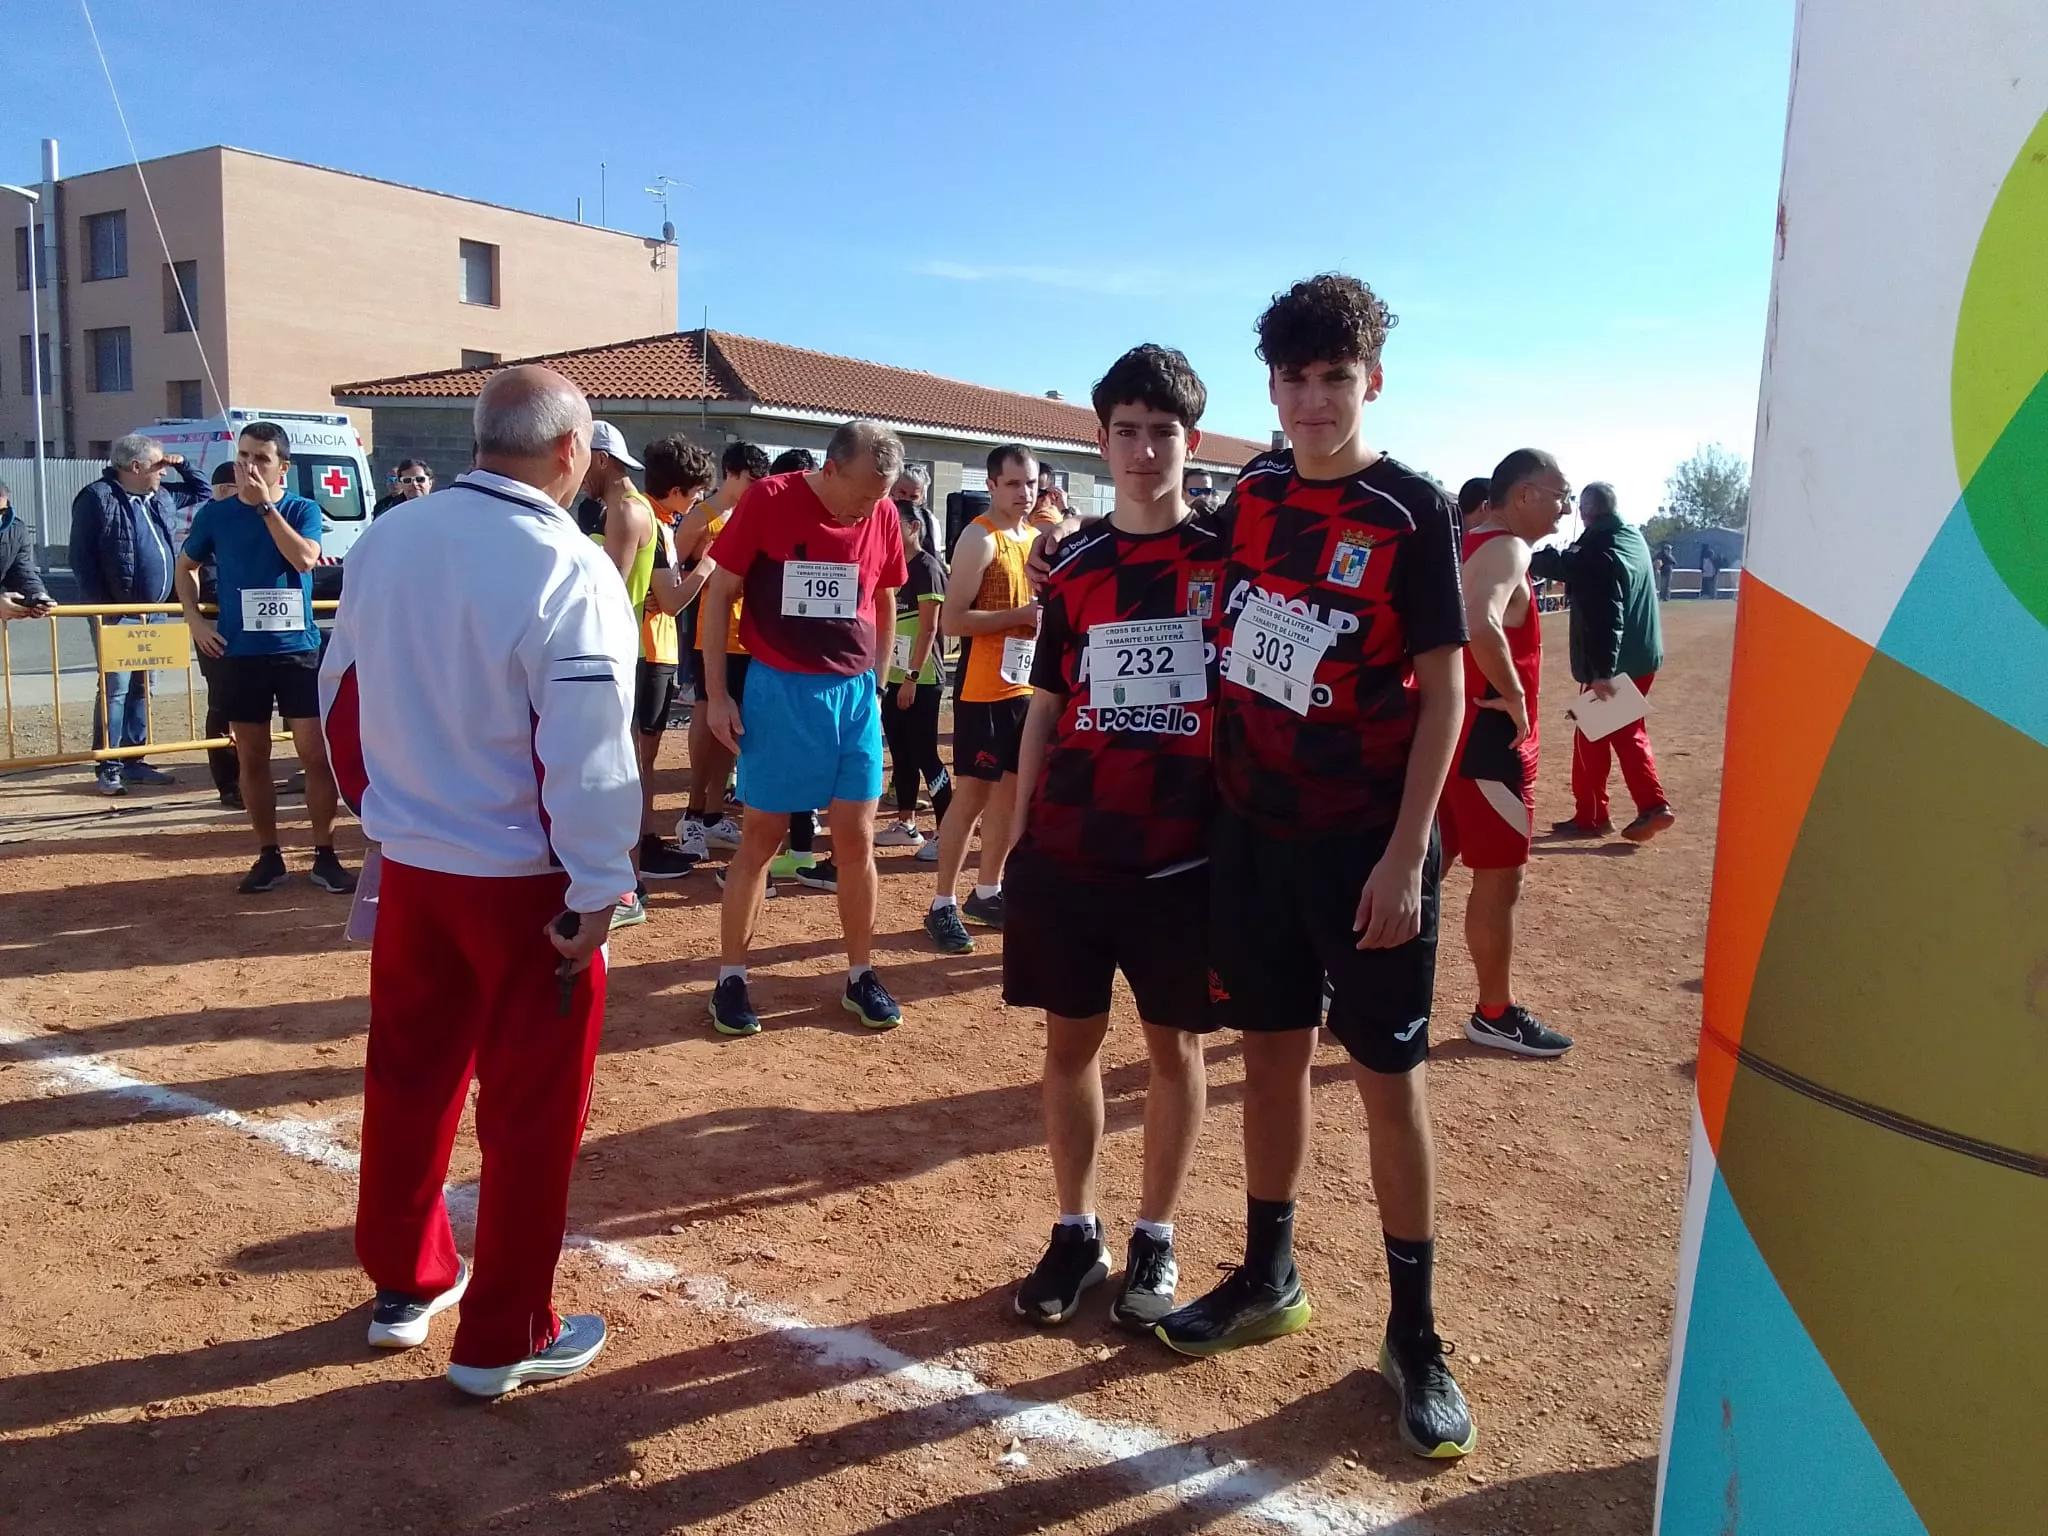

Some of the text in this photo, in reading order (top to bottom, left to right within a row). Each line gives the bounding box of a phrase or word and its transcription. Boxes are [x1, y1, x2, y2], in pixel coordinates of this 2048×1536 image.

[289, 433, 347, 447] ULANCIA
[804, 579, 839, 598] 196
[257, 602, 288, 616] 280
[1256, 605, 1314, 635] CROSS DE LA LITERA
[1105, 627, 1129, 636] CROSS
[1155, 623, 1183, 632] LITERA
[1253, 615, 1310, 644] TAMARITE DE LITERA
[137, 643, 152, 652] DE
[1105, 636, 1143, 646] TAMARITE
[1156, 633, 1184, 641] LITERA
[1252, 631, 1295, 673] 303
[118, 656, 174, 667] TAMARITE
[1017, 653, 1032, 669] 19
[1116, 646, 1175, 677] 232
[1097, 705, 1200, 736] Pociello
